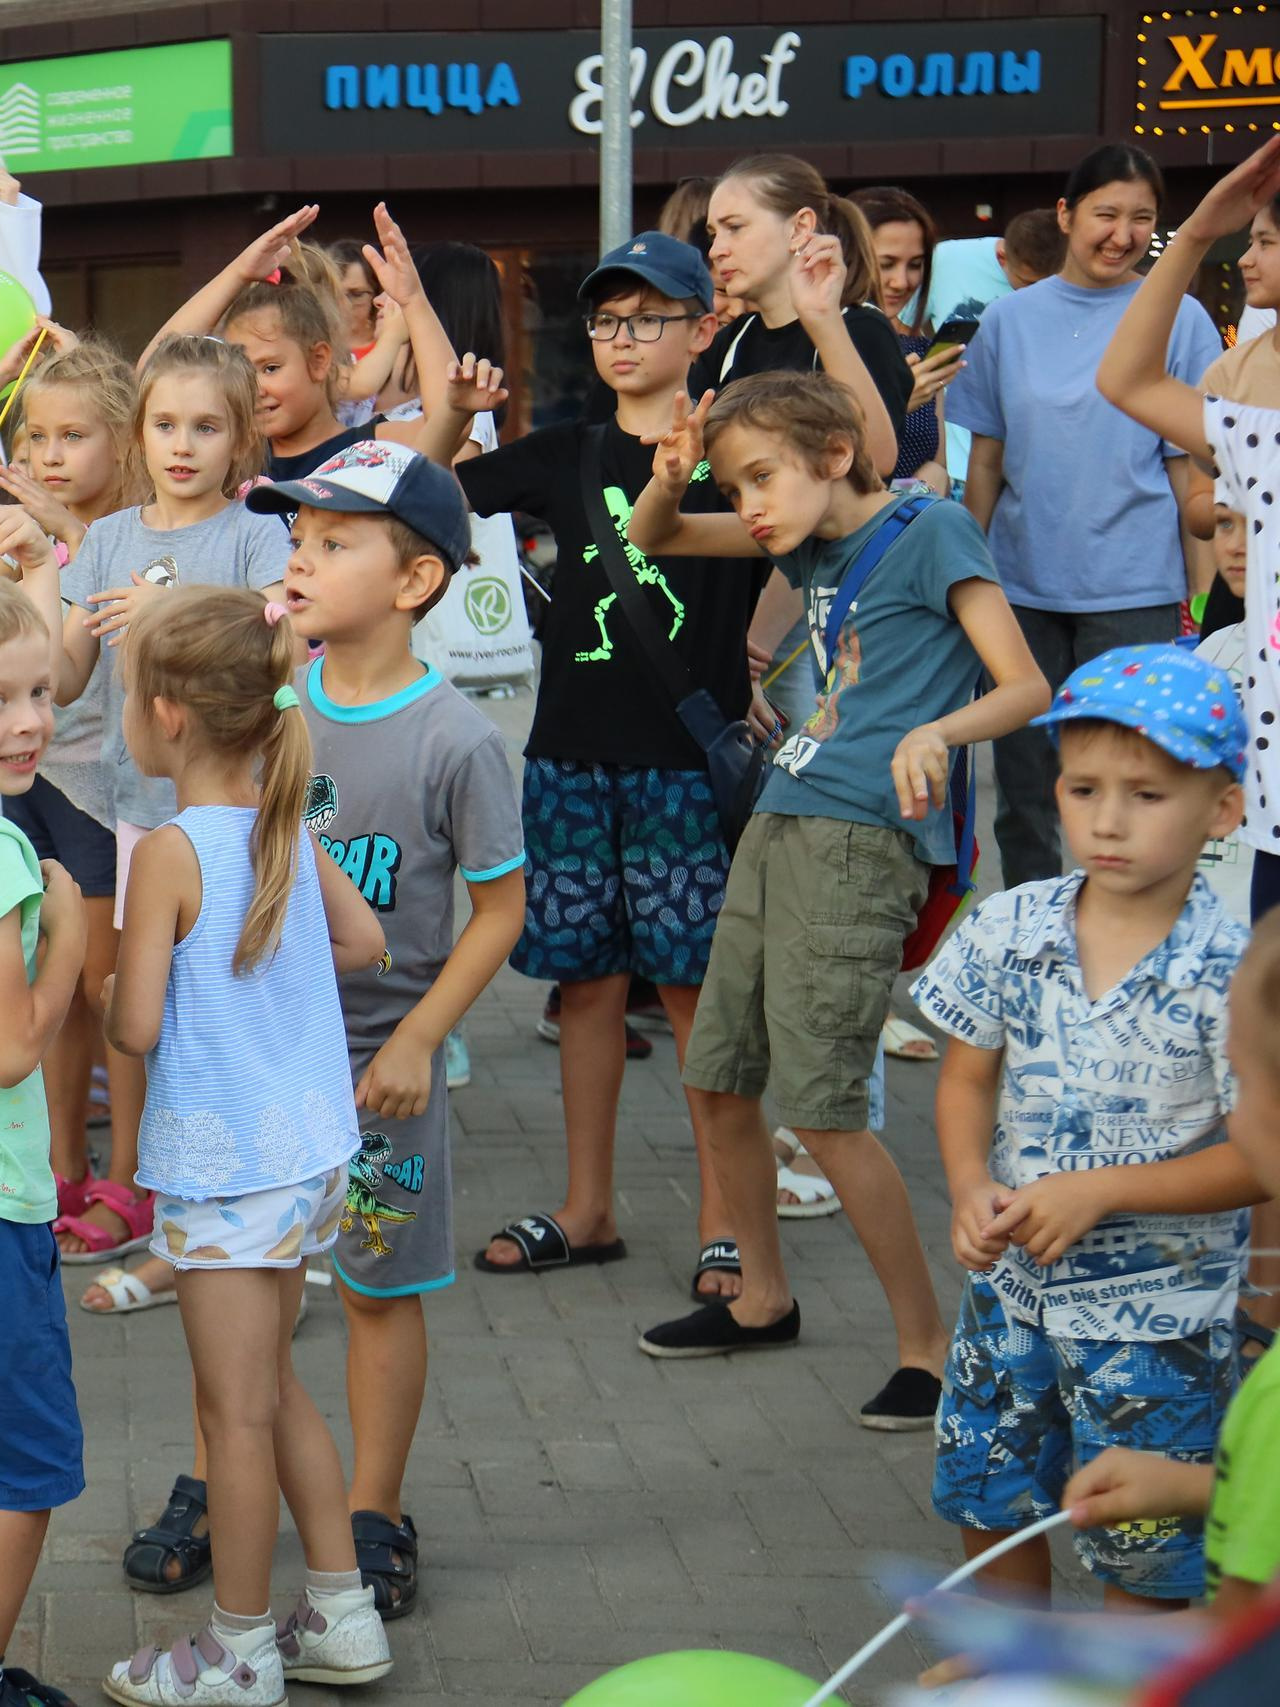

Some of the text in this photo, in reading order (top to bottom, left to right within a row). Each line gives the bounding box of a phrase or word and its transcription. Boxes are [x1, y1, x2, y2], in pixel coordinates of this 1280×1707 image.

[651, 31, 802, 127] Chef
[844, 49, 1042, 98] РОЛЛЫ
[1161, 33, 1280, 92] Хм
[325, 61, 521, 116] ПИЦЦА
[925, 984, 978, 1037] Faith
[1064, 1056, 1172, 1089] SPORTS
[1094, 1124, 1179, 1147] NEWS
[382, 1154, 425, 1194] ROAR
[993, 1266, 1039, 1312] Faith
[1069, 1287, 1098, 1305] big
[1099, 1277, 1164, 1300] stories
[1167, 1269, 1186, 1289] of
